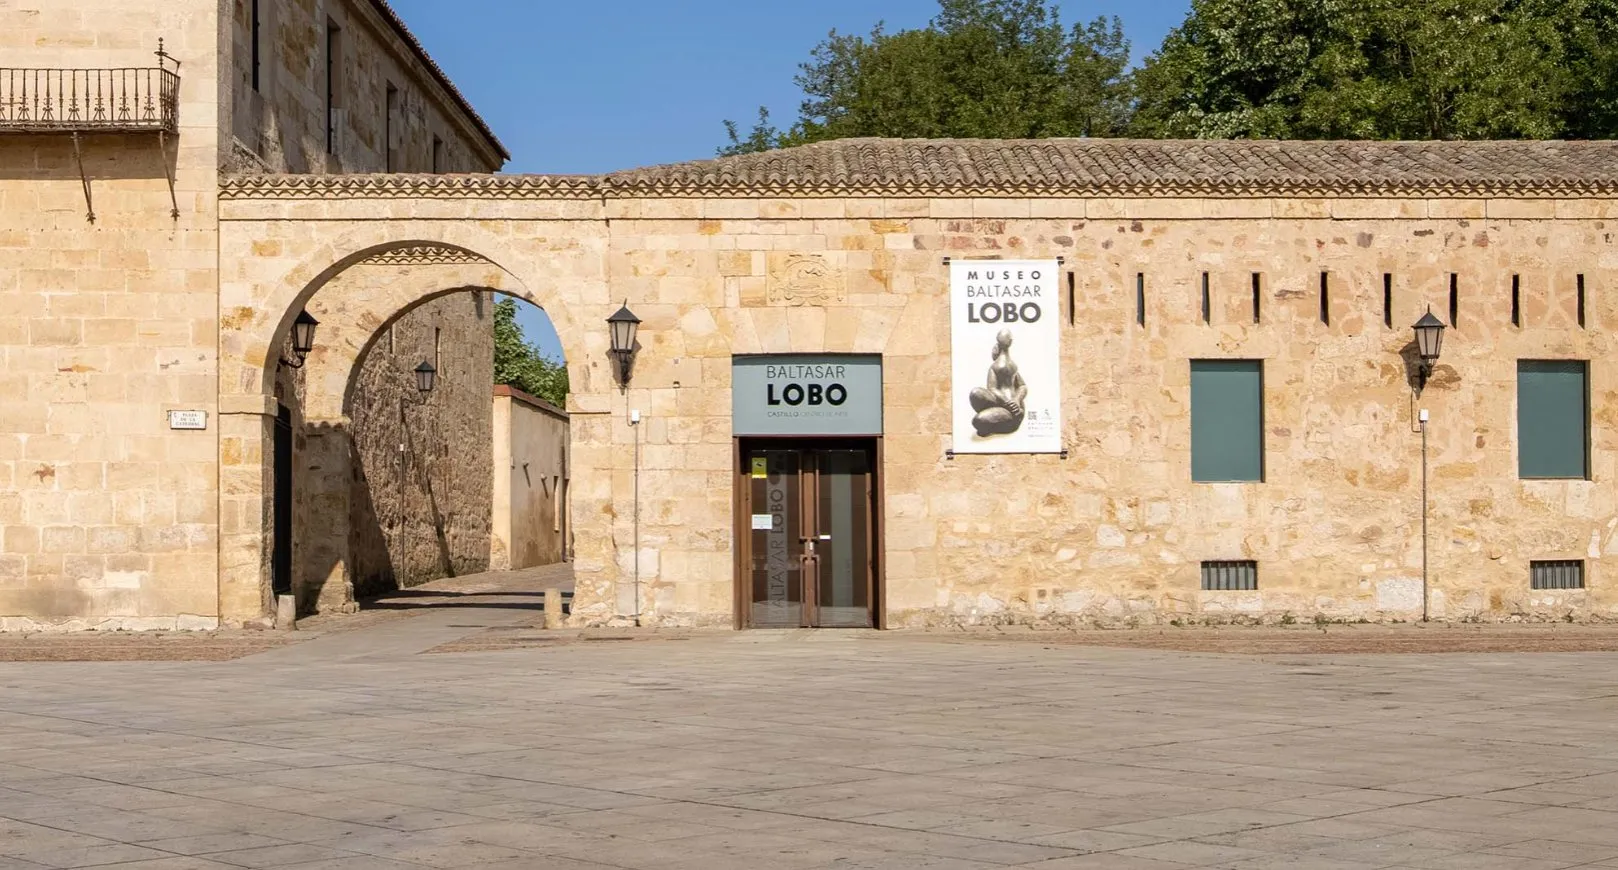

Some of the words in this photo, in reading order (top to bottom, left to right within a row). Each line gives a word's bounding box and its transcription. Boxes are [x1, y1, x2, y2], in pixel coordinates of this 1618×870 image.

[967, 270, 1042, 280] MUSEO
[967, 285, 1042, 298] BALTASAR
[967, 302, 1042, 324] LOBO
[766, 365, 846, 379] BALTASAR
[767, 383, 848, 406] LOBO
[770, 489, 784, 534] LOBO
